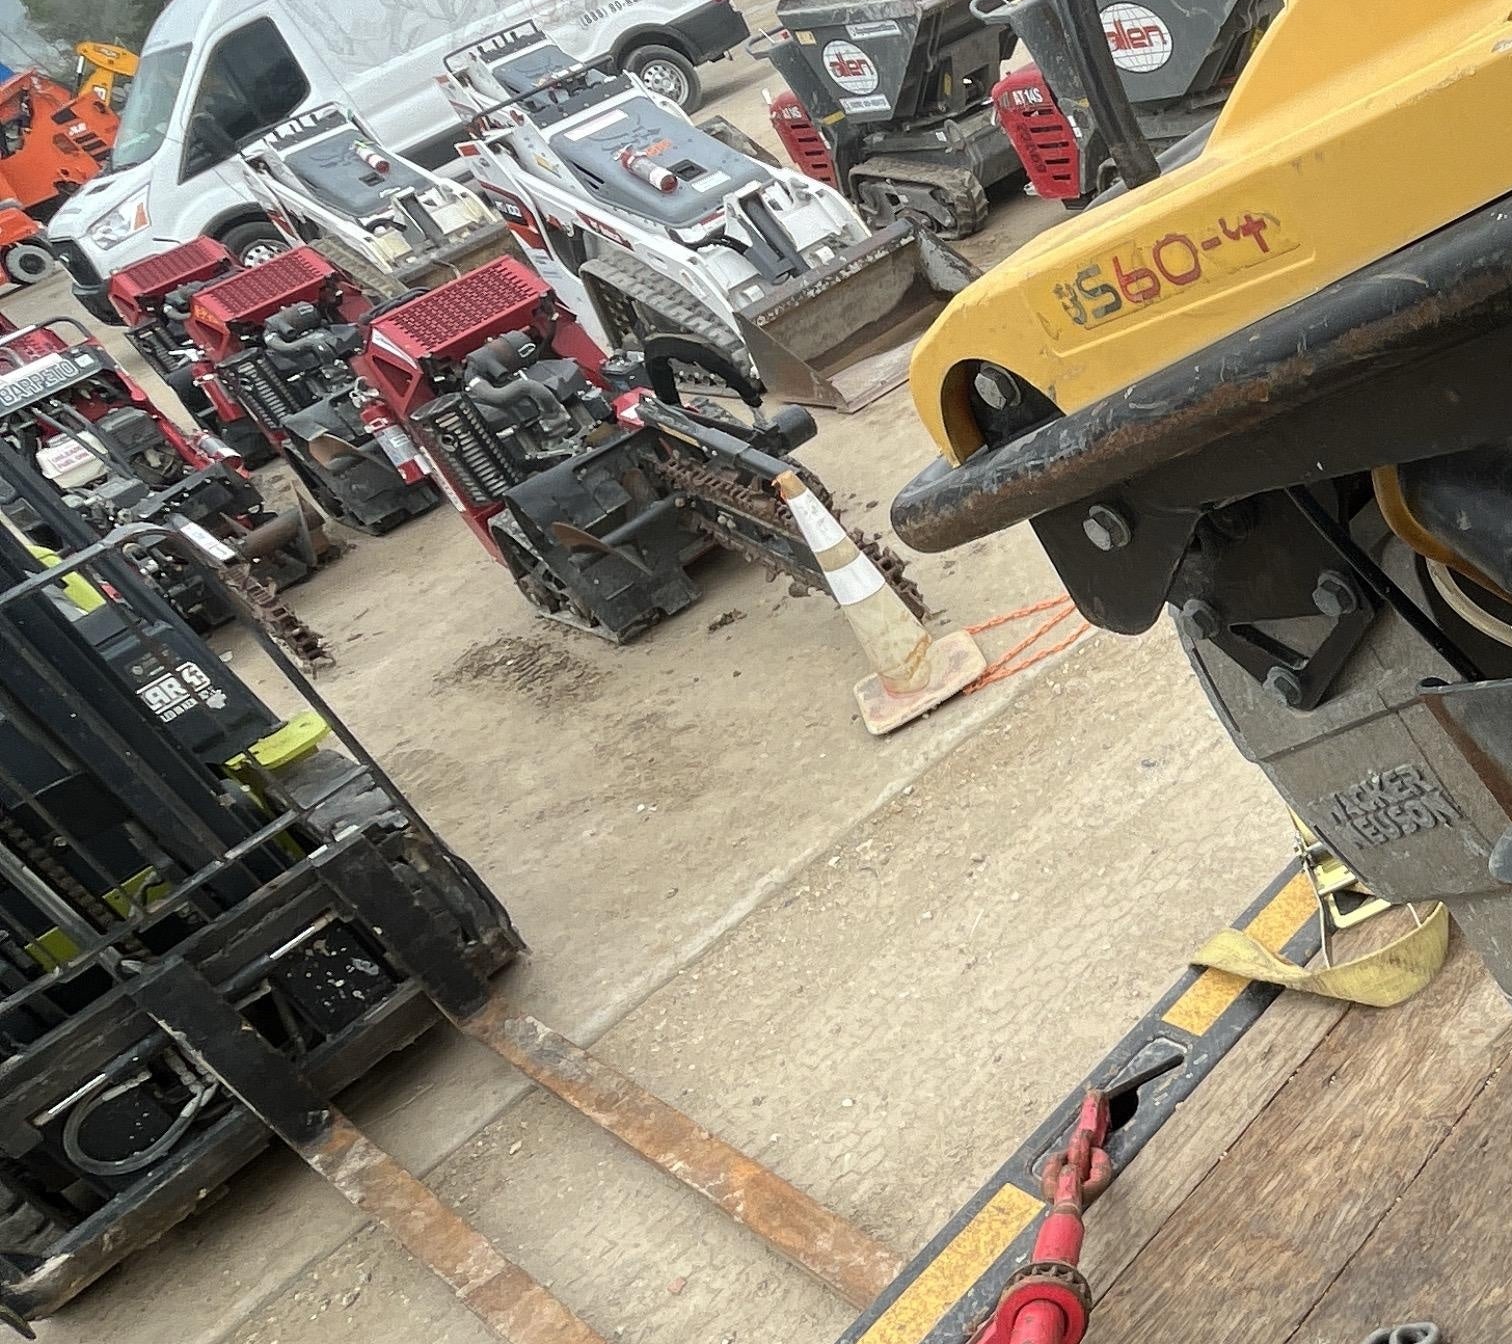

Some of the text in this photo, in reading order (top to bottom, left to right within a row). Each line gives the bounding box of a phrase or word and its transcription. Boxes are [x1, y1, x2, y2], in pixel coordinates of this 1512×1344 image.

[829, 50, 875, 77] allen
[1012, 88, 1043, 106] AT14S
[0, 359, 78, 406] BARRETO
